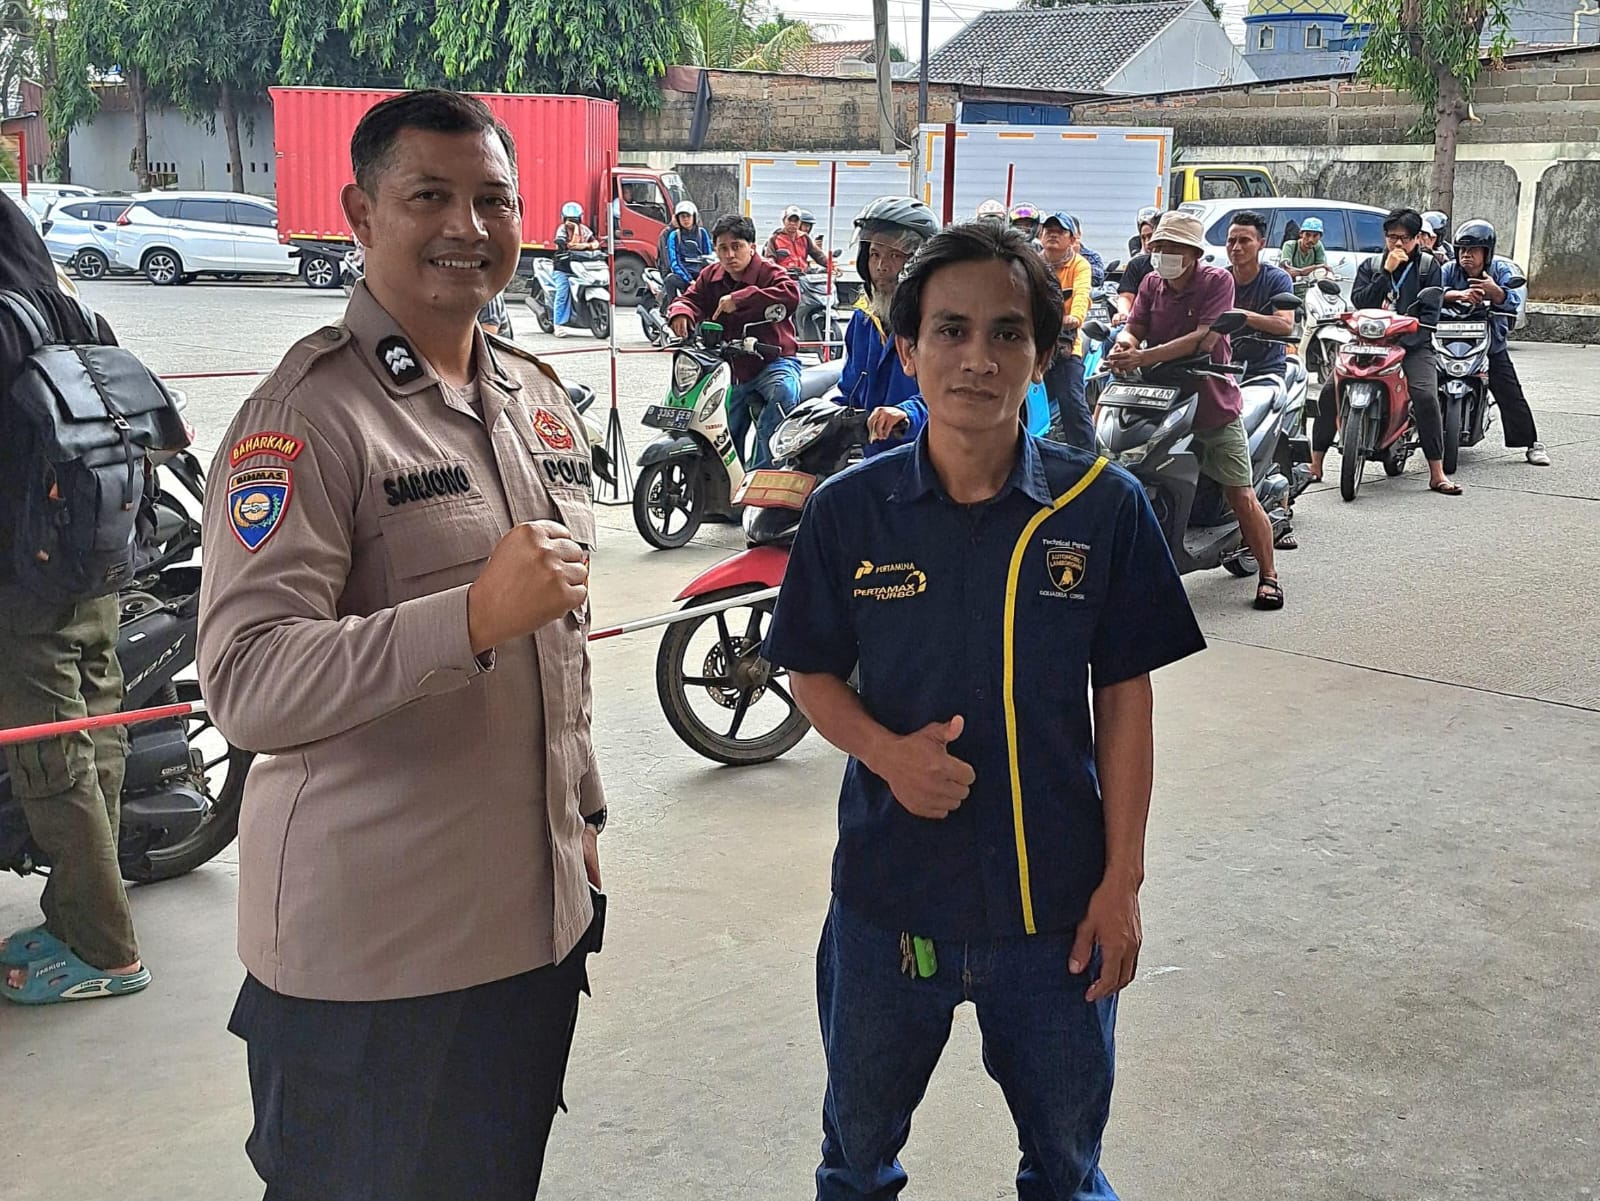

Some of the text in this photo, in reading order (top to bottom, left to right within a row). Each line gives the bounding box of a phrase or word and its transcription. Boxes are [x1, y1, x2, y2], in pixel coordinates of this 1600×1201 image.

[233, 435, 296, 460] BAHARKAM
[383, 465, 471, 507] SARJONO
[875, 562, 916, 575] PERTAMINA
[875, 590, 916, 601] TURBO
